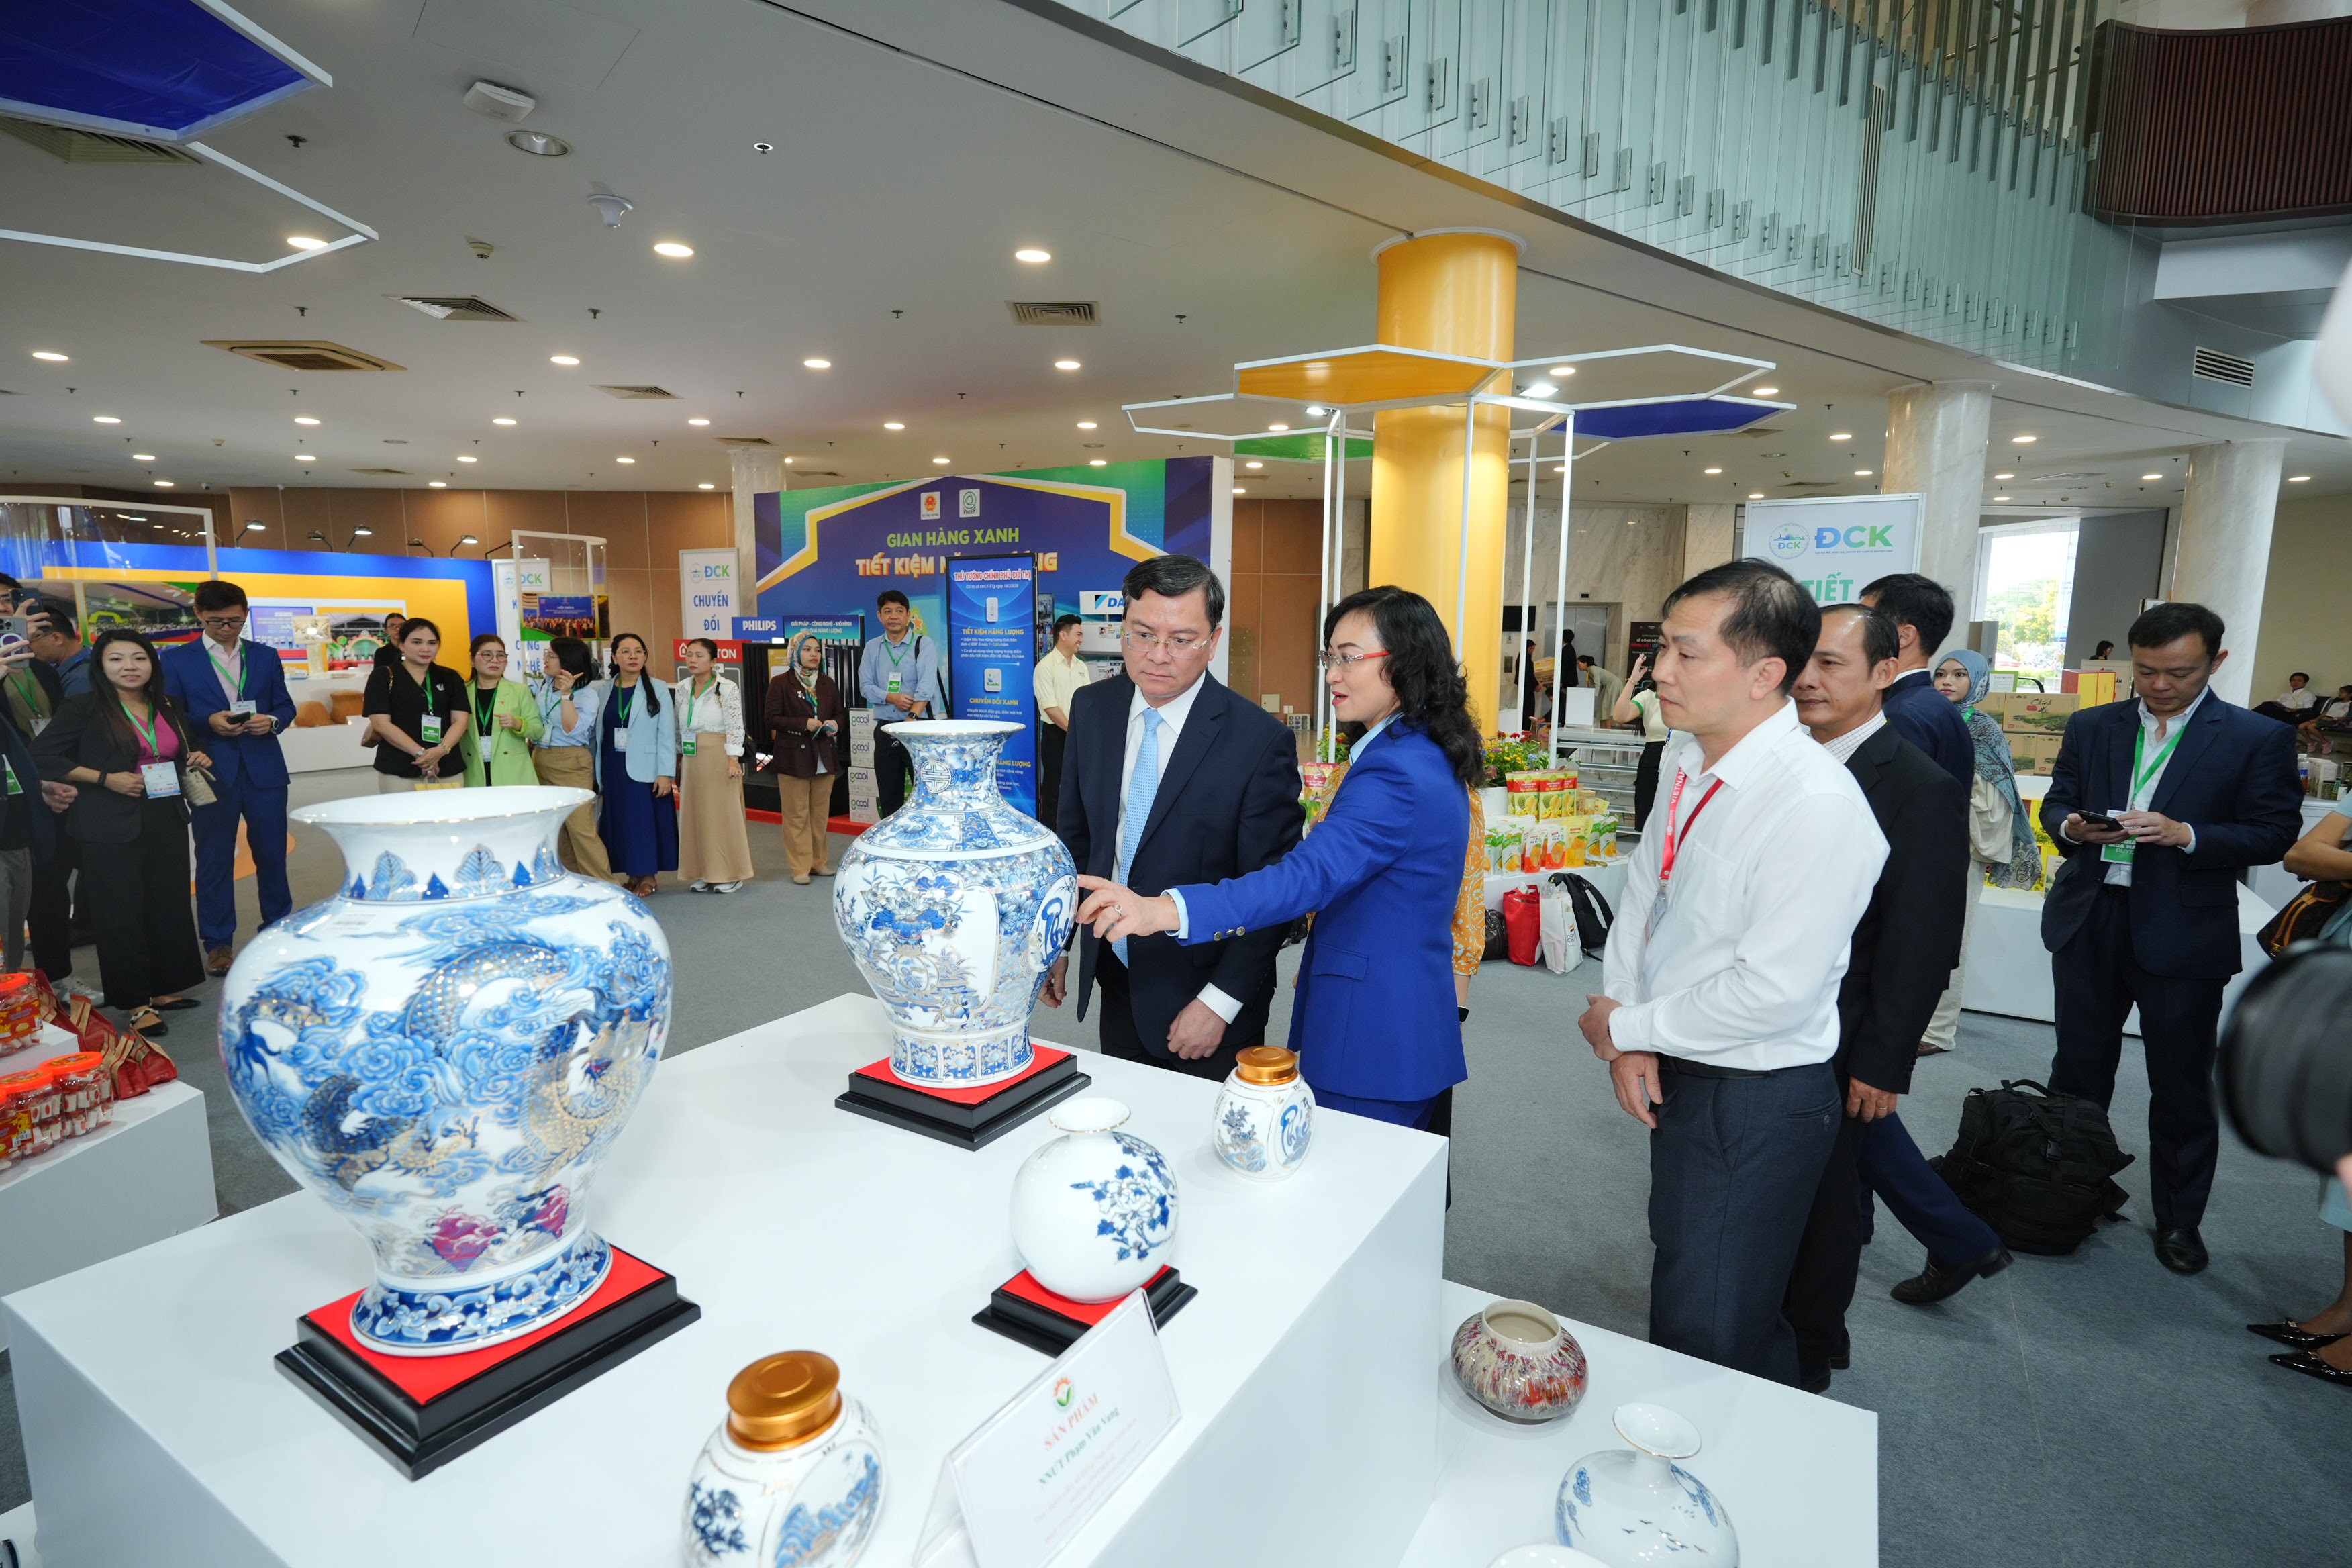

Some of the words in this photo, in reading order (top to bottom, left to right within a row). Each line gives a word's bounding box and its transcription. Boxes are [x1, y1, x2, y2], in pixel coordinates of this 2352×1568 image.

[887, 532, 922, 548] GIAN
[926, 527, 970, 546] HÀNG
[973, 528, 1019, 544] XANH
[1814, 524, 1894, 549] ĐCK
[1777, 542, 1801, 550] ĐCK
[704, 565, 730, 577] ĐCK
[856, 552, 891, 576] TIẾT
[895, 553, 935, 578] KIỆM
[954, 569, 965, 581] THỦ
[983, 569, 999, 581] CHÍNH
[1000, 569, 1012, 580] PHỦ
[1012, 568, 1022, 580] CHỈ
[1022, 570, 1032, 581] THỊ
[1800, 572, 1854, 601] TIẾT
[693, 589, 729, 607] CHUYỂN
[1108, 597, 1125, 607] DA
[703, 614, 720, 631] ĐỔI
[742, 620, 777, 632] PHILIPS
[962, 626, 973, 634] TIẾT
[974, 627, 987, 636] KIỆM
[516, 640, 540, 650] CNG
[717, 648, 736, 659] TON
[969, 696, 991, 704] CHUYỂN
[992, 696, 1002, 705] ĐỔI
[851, 714, 869, 727] gcool
[852, 742, 870, 754] gcool
[1012, 760, 1032, 768] LƯỢNG
[850, 770, 868, 783] gcool
[851, 798, 869, 810] gcool
